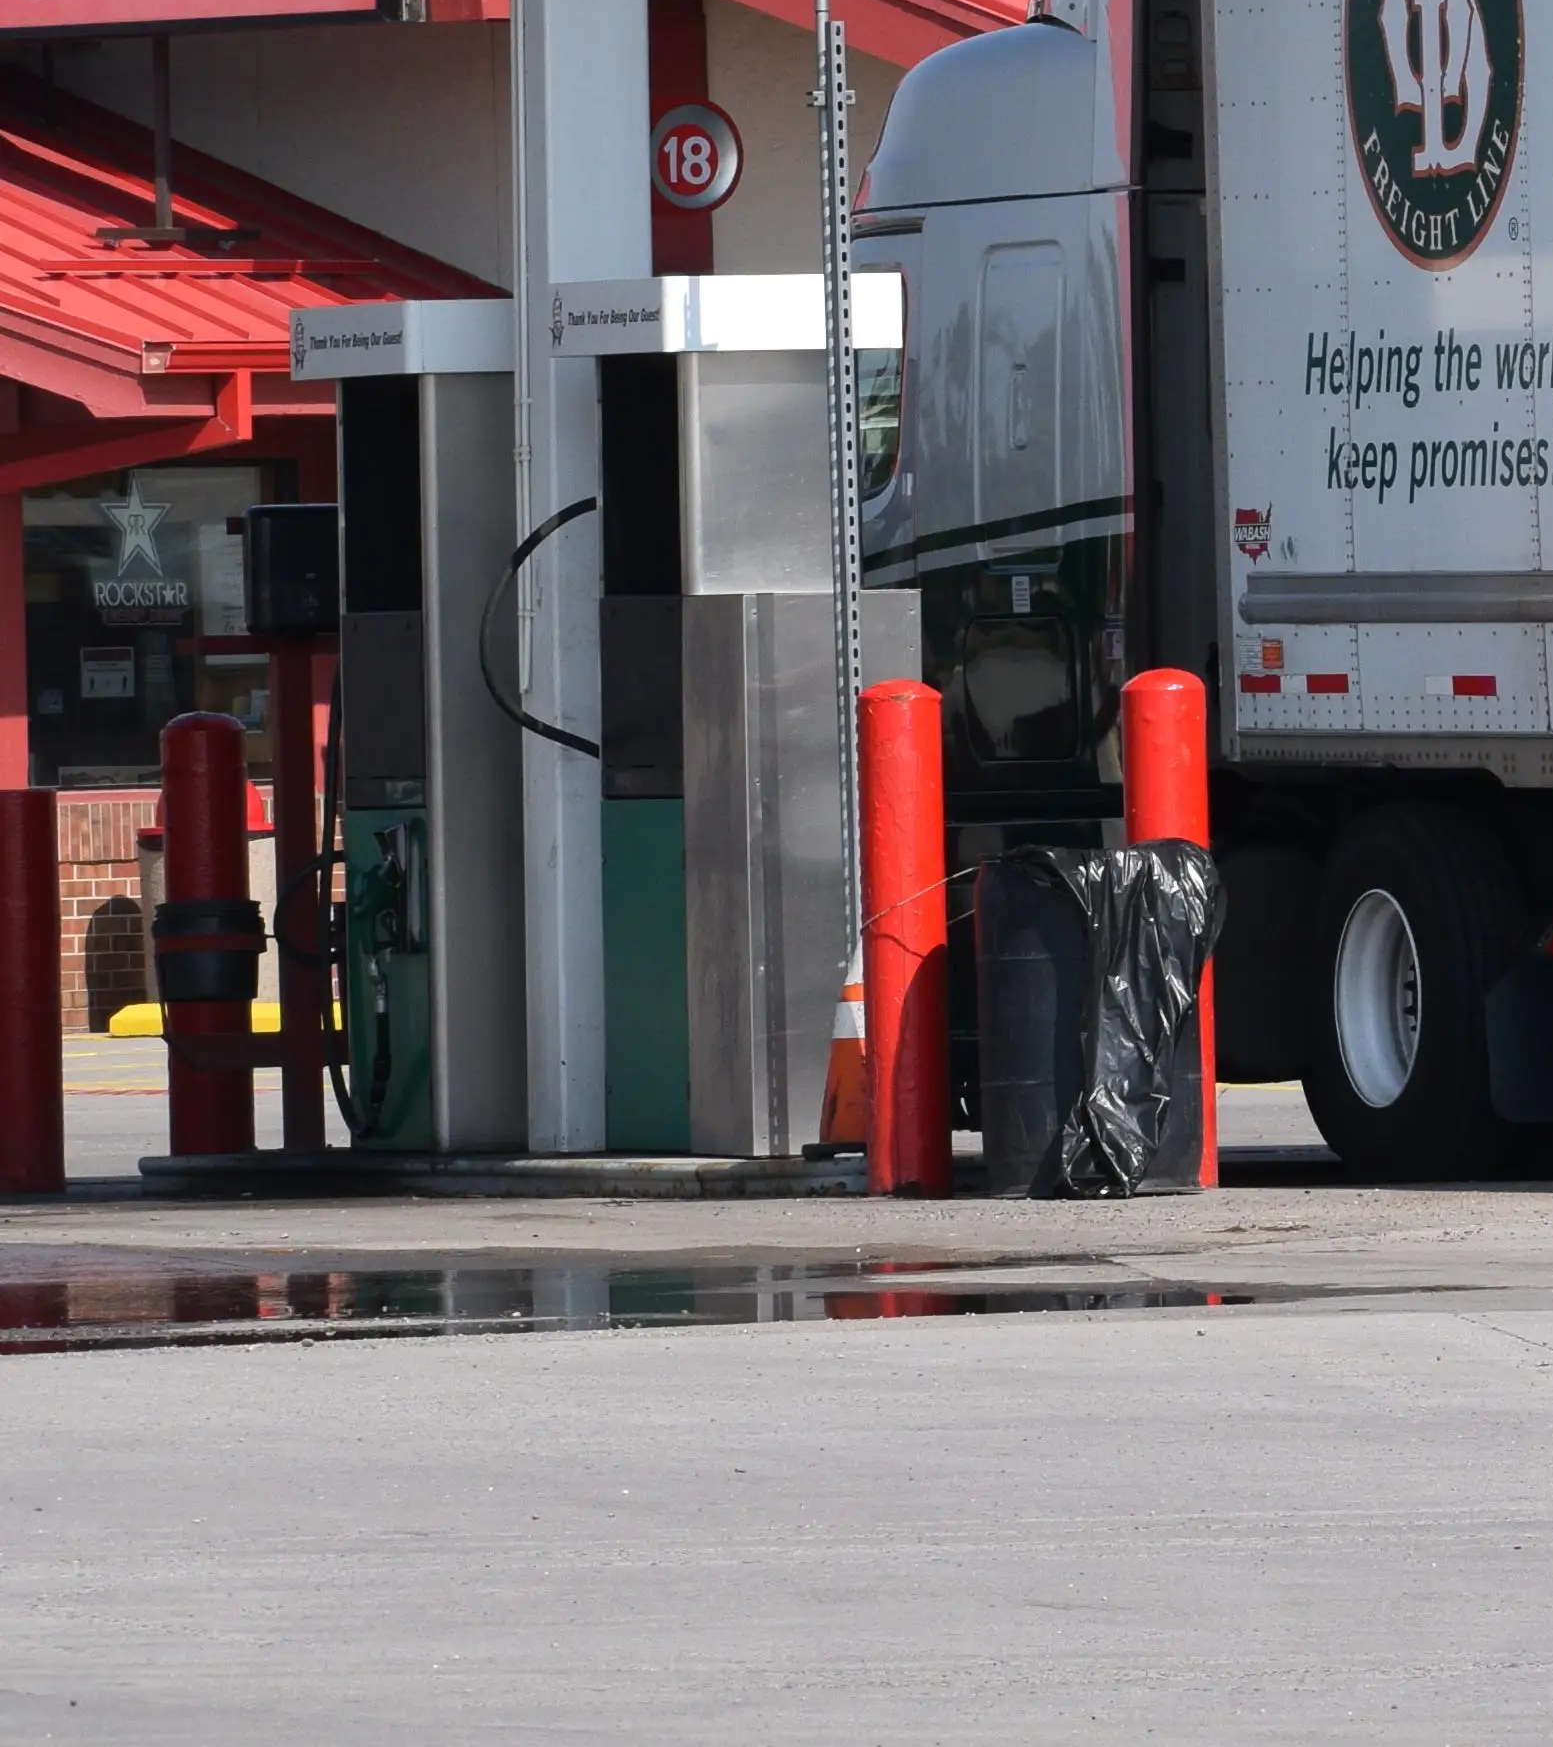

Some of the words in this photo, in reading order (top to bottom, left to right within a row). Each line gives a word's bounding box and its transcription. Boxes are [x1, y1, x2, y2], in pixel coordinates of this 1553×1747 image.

[662, 134, 713, 186] 18
[1361, 123, 1461, 252] FREIGHT
[1468, 117, 1511, 228] LINE
[1304, 329, 1421, 410] Helping
[1433, 327, 1482, 392] the
[1327, 425, 1398, 497] keep
[1234, 525, 1270, 542] WABASH
